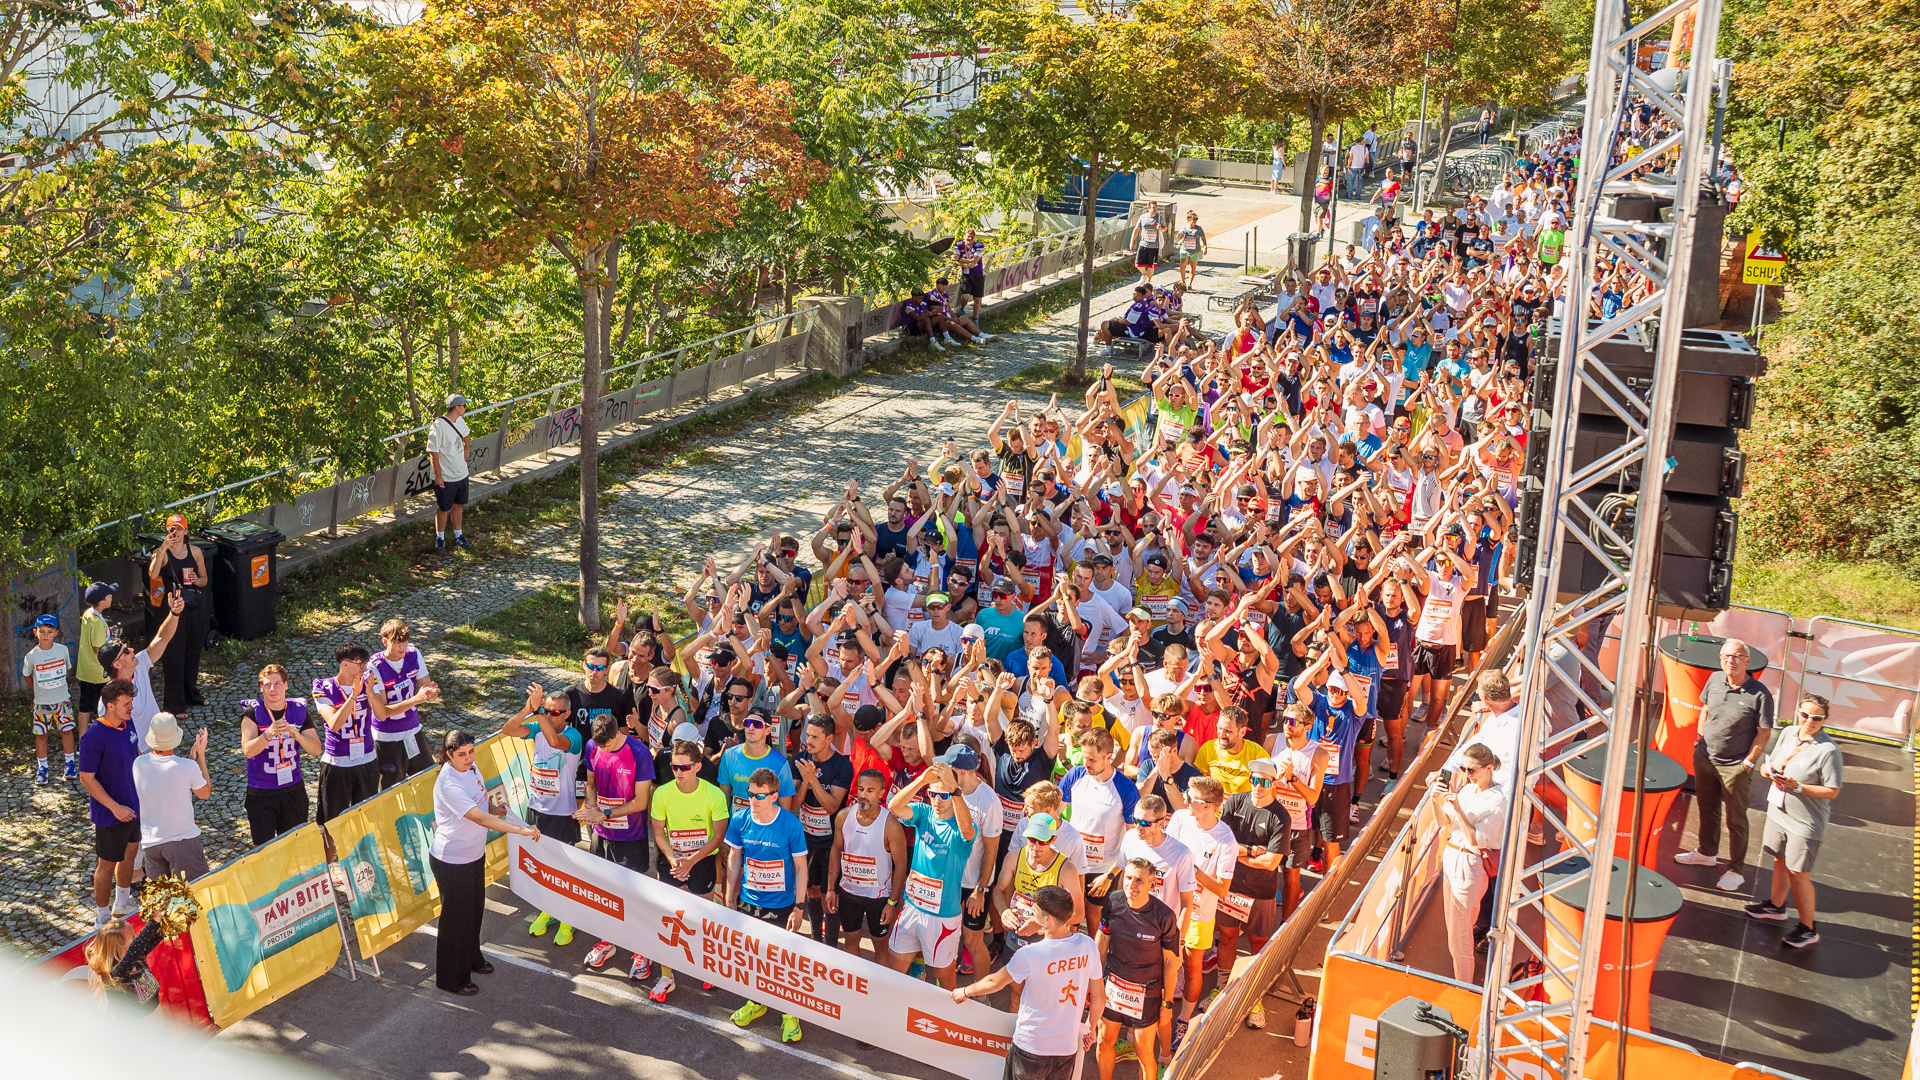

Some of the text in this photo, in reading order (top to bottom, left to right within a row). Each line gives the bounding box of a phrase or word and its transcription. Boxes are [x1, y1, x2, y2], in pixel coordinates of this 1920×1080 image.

[263, 736, 298, 775] 39
[1002, 810, 1021, 820] 458B
[1203, 851, 1213, 859] EY
[758, 871, 782, 880] 7692A
[850, 866, 876, 875] 10388C
[1155, 869, 1166, 877] EY
[540, 870, 619, 913] WIEN ENERGIE
[918, 887, 937, 898] 213B
[267, 929, 294, 947] PROTEIN
[701, 916, 869, 996] WIEN ENERGIE
[702, 936, 815, 993] BUSINESS
[1046, 954, 1089, 975] CREW
[702, 956, 840, 1017] RUN DONAUINSEL
[1116, 991, 1140, 1004] 6668A
[944, 1027, 983, 1046] WIEN
